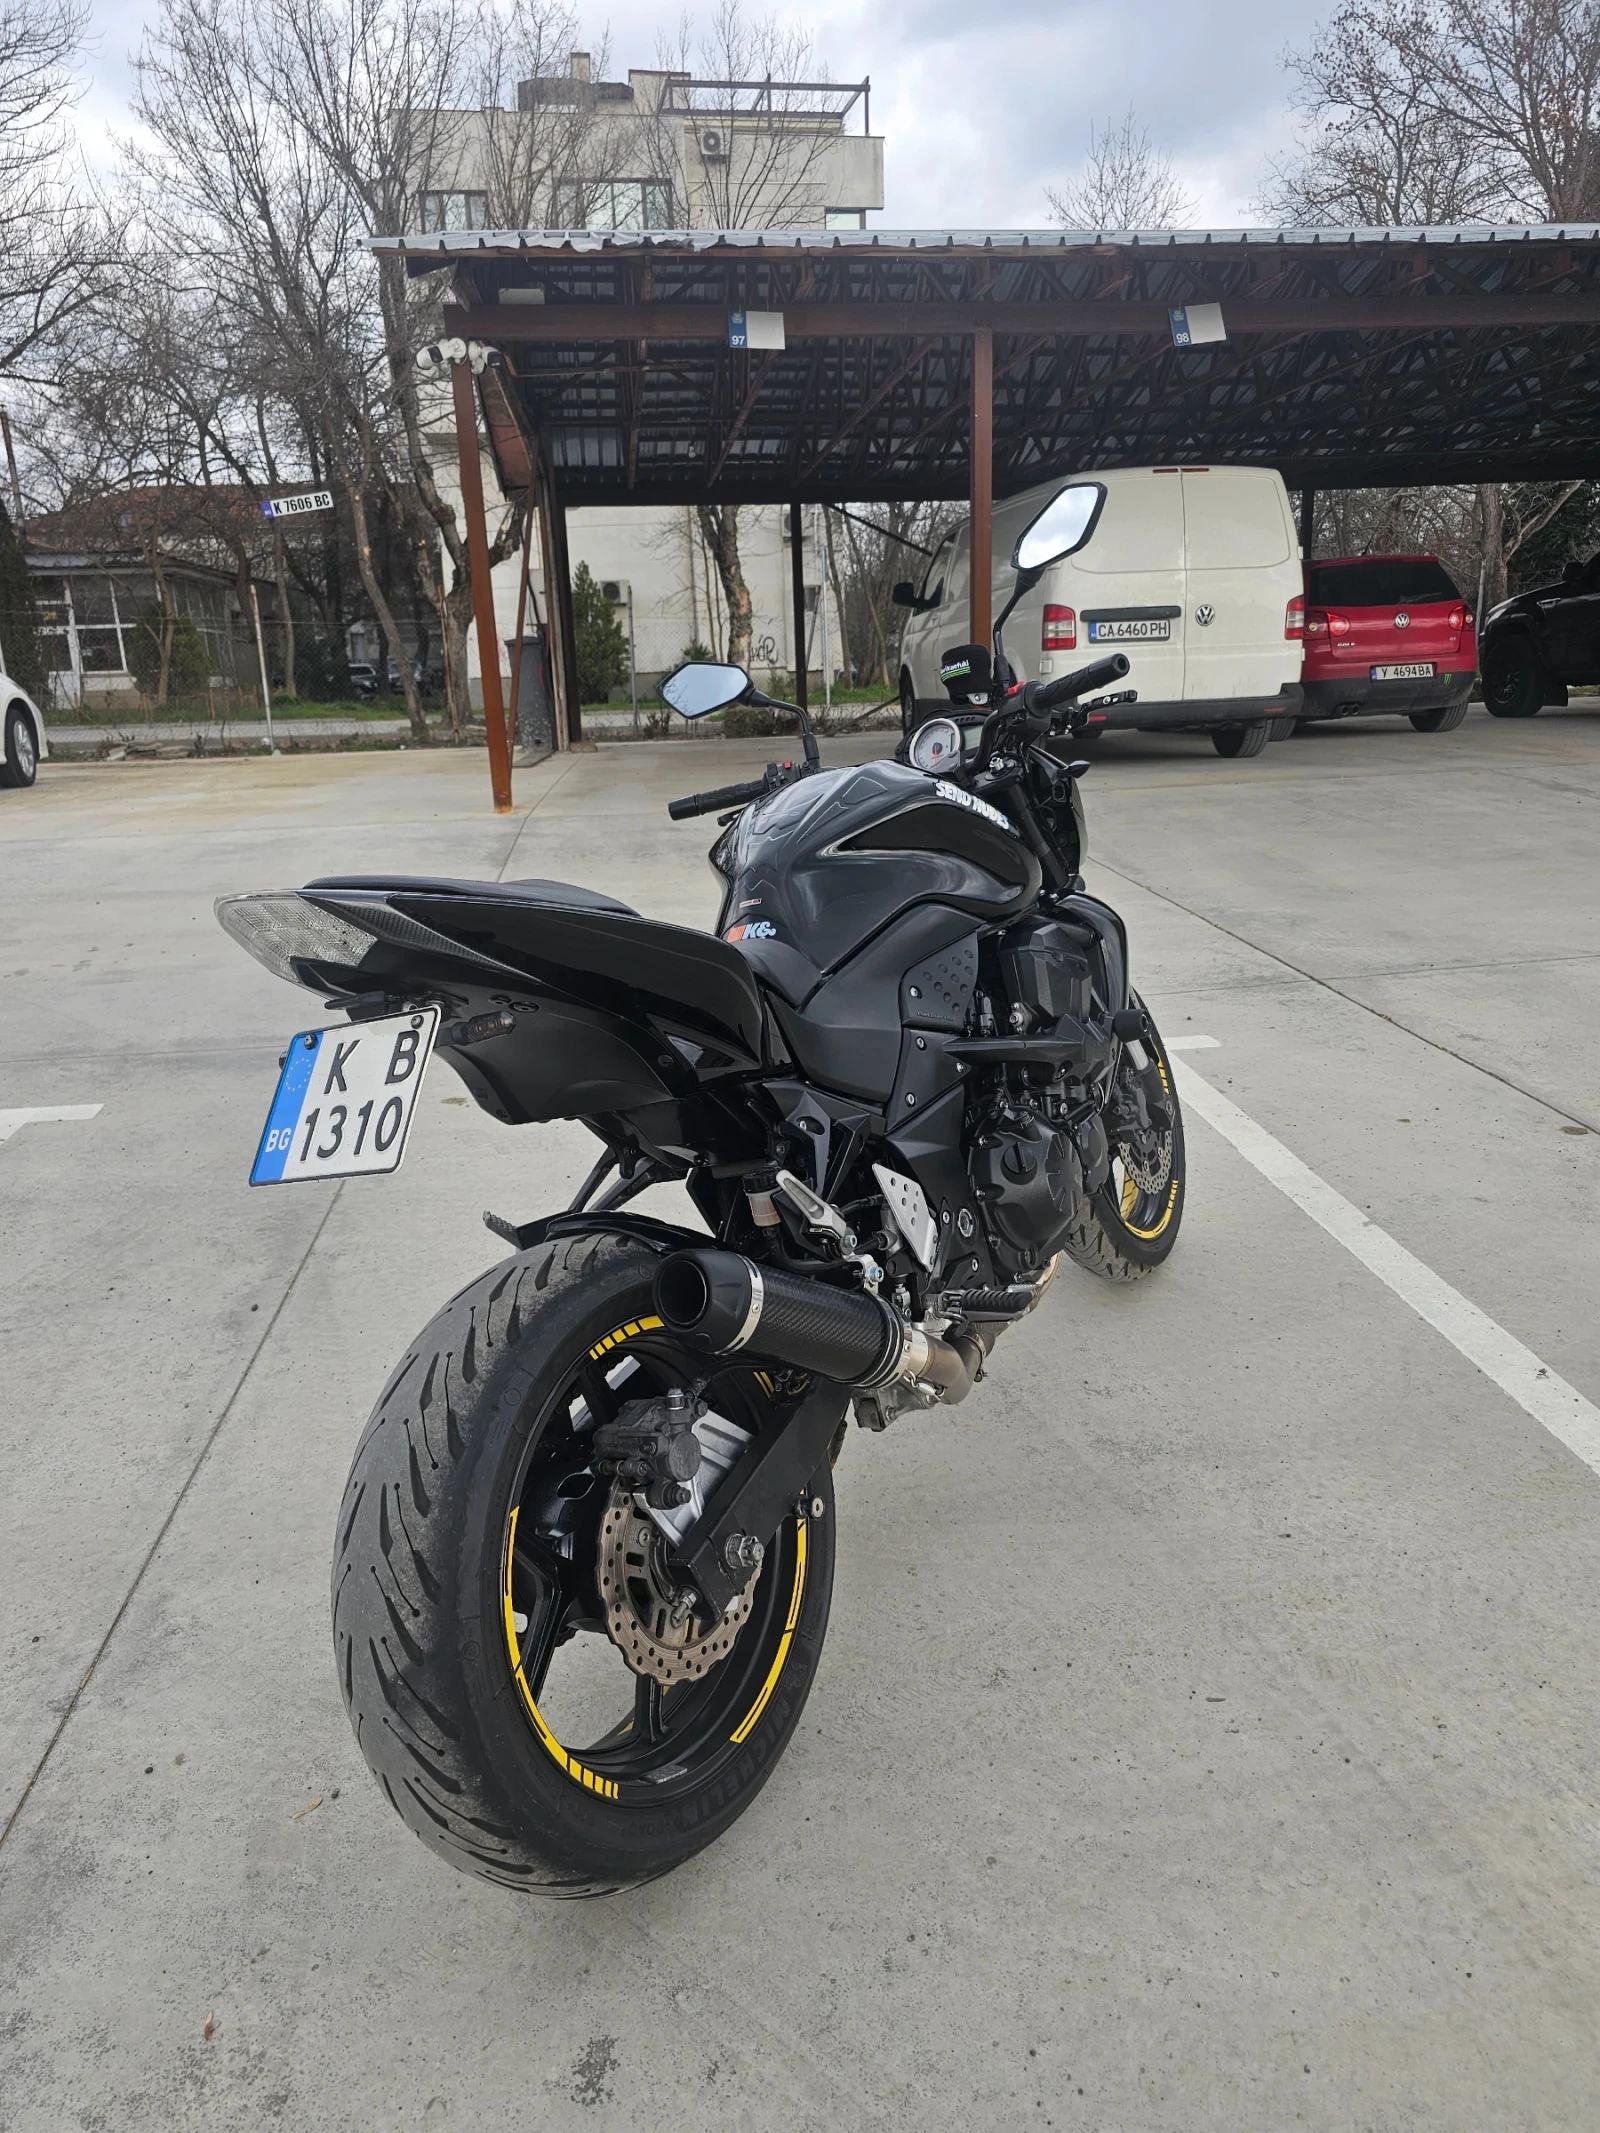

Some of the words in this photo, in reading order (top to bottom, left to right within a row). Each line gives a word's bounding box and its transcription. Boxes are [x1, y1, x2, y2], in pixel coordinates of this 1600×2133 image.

[731, 335, 745, 345] 97
[1176, 332, 1189, 343] 98
[273, 502, 282, 514] K
[283, 497, 312, 512] 7606
[314, 494, 329, 507] BC
[1098, 624, 1114, 638] CA
[1117, 623, 1148, 636] 6460
[1150, 622, 1167, 635] PH
[1381, 668, 1388, 678] Y
[936, 780, 972, 806] SEND
[972, 795, 1009, 830] NUDES
[323, 1039, 361, 1095] K
[385, 1030, 420, 1085] B
[300, 1096, 402, 1162] 1310
[265, 1128, 292, 1153] BG
[680, 1695, 792, 1827] MICHELIN
